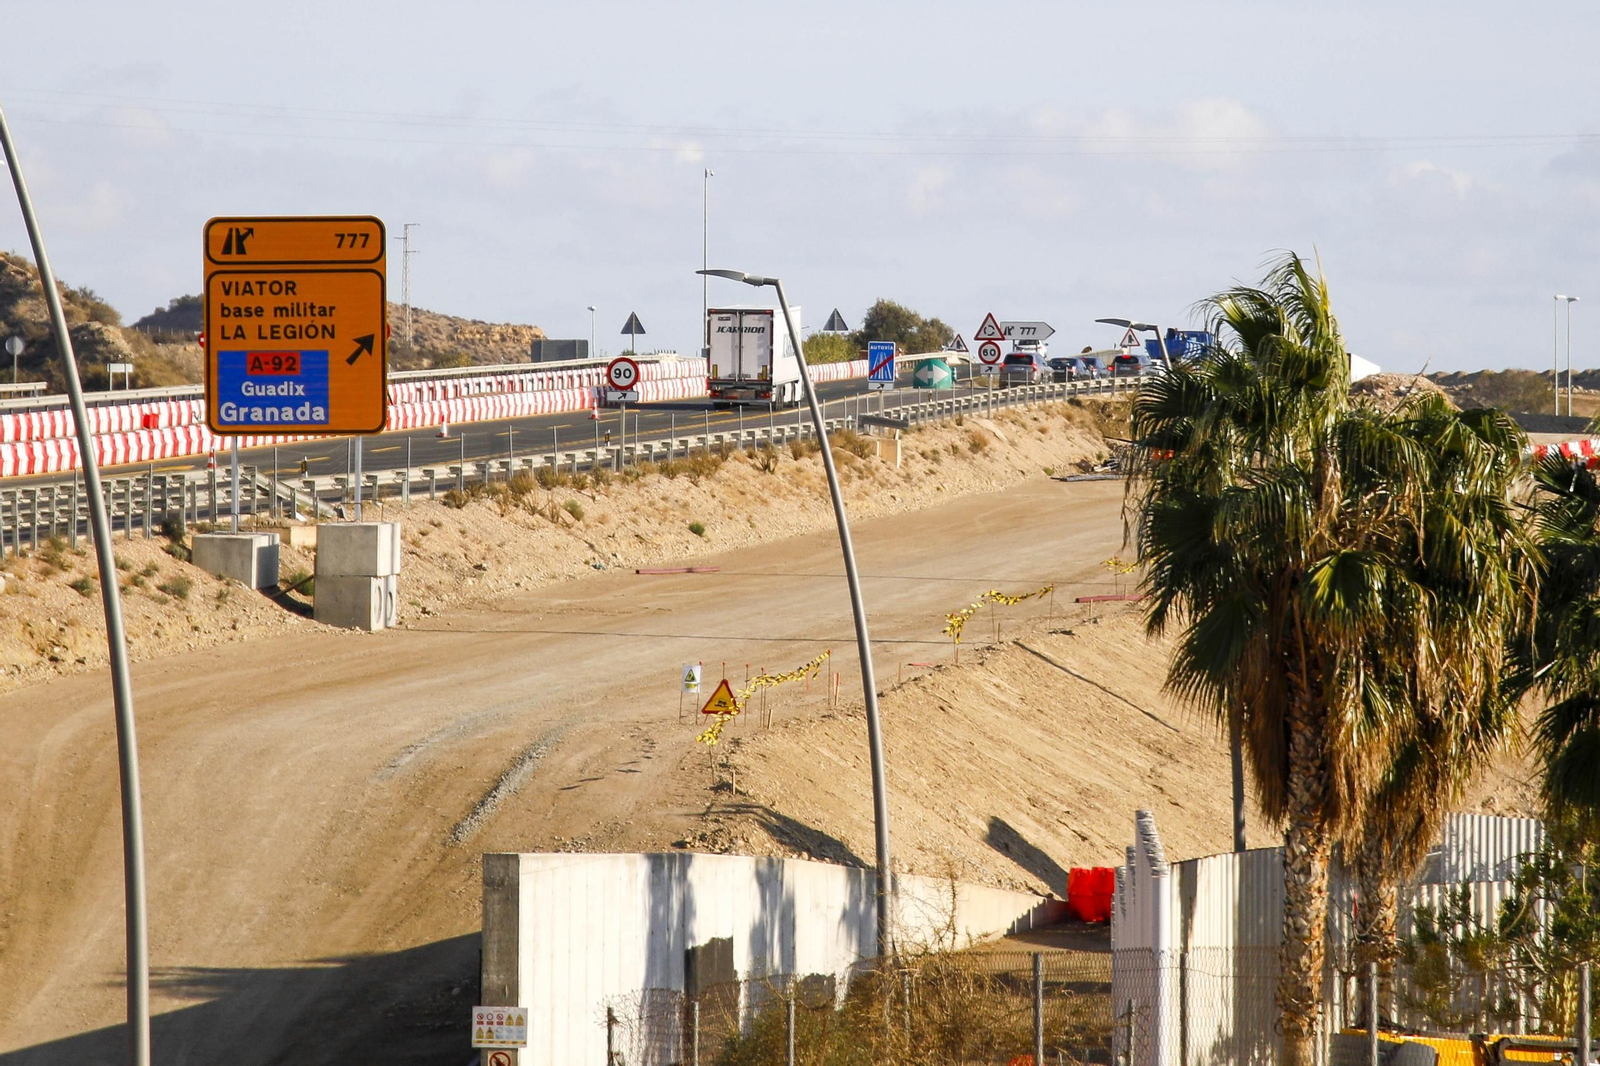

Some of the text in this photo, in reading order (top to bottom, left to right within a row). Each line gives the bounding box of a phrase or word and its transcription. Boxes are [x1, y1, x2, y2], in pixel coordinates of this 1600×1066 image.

[334, 233, 370, 249] 777
[221, 280, 298, 296] VIATOR
[220, 302, 336, 318] base militar
[220, 320, 336, 340] LA LEGIÓN
[1019, 327, 1037, 335] 777
[982, 348, 997, 357] 60
[250, 356, 297, 371] A-92
[613, 367, 632, 379] 90
[241, 381, 305, 396] Guadix
[219, 401, 326, 422] Granada
